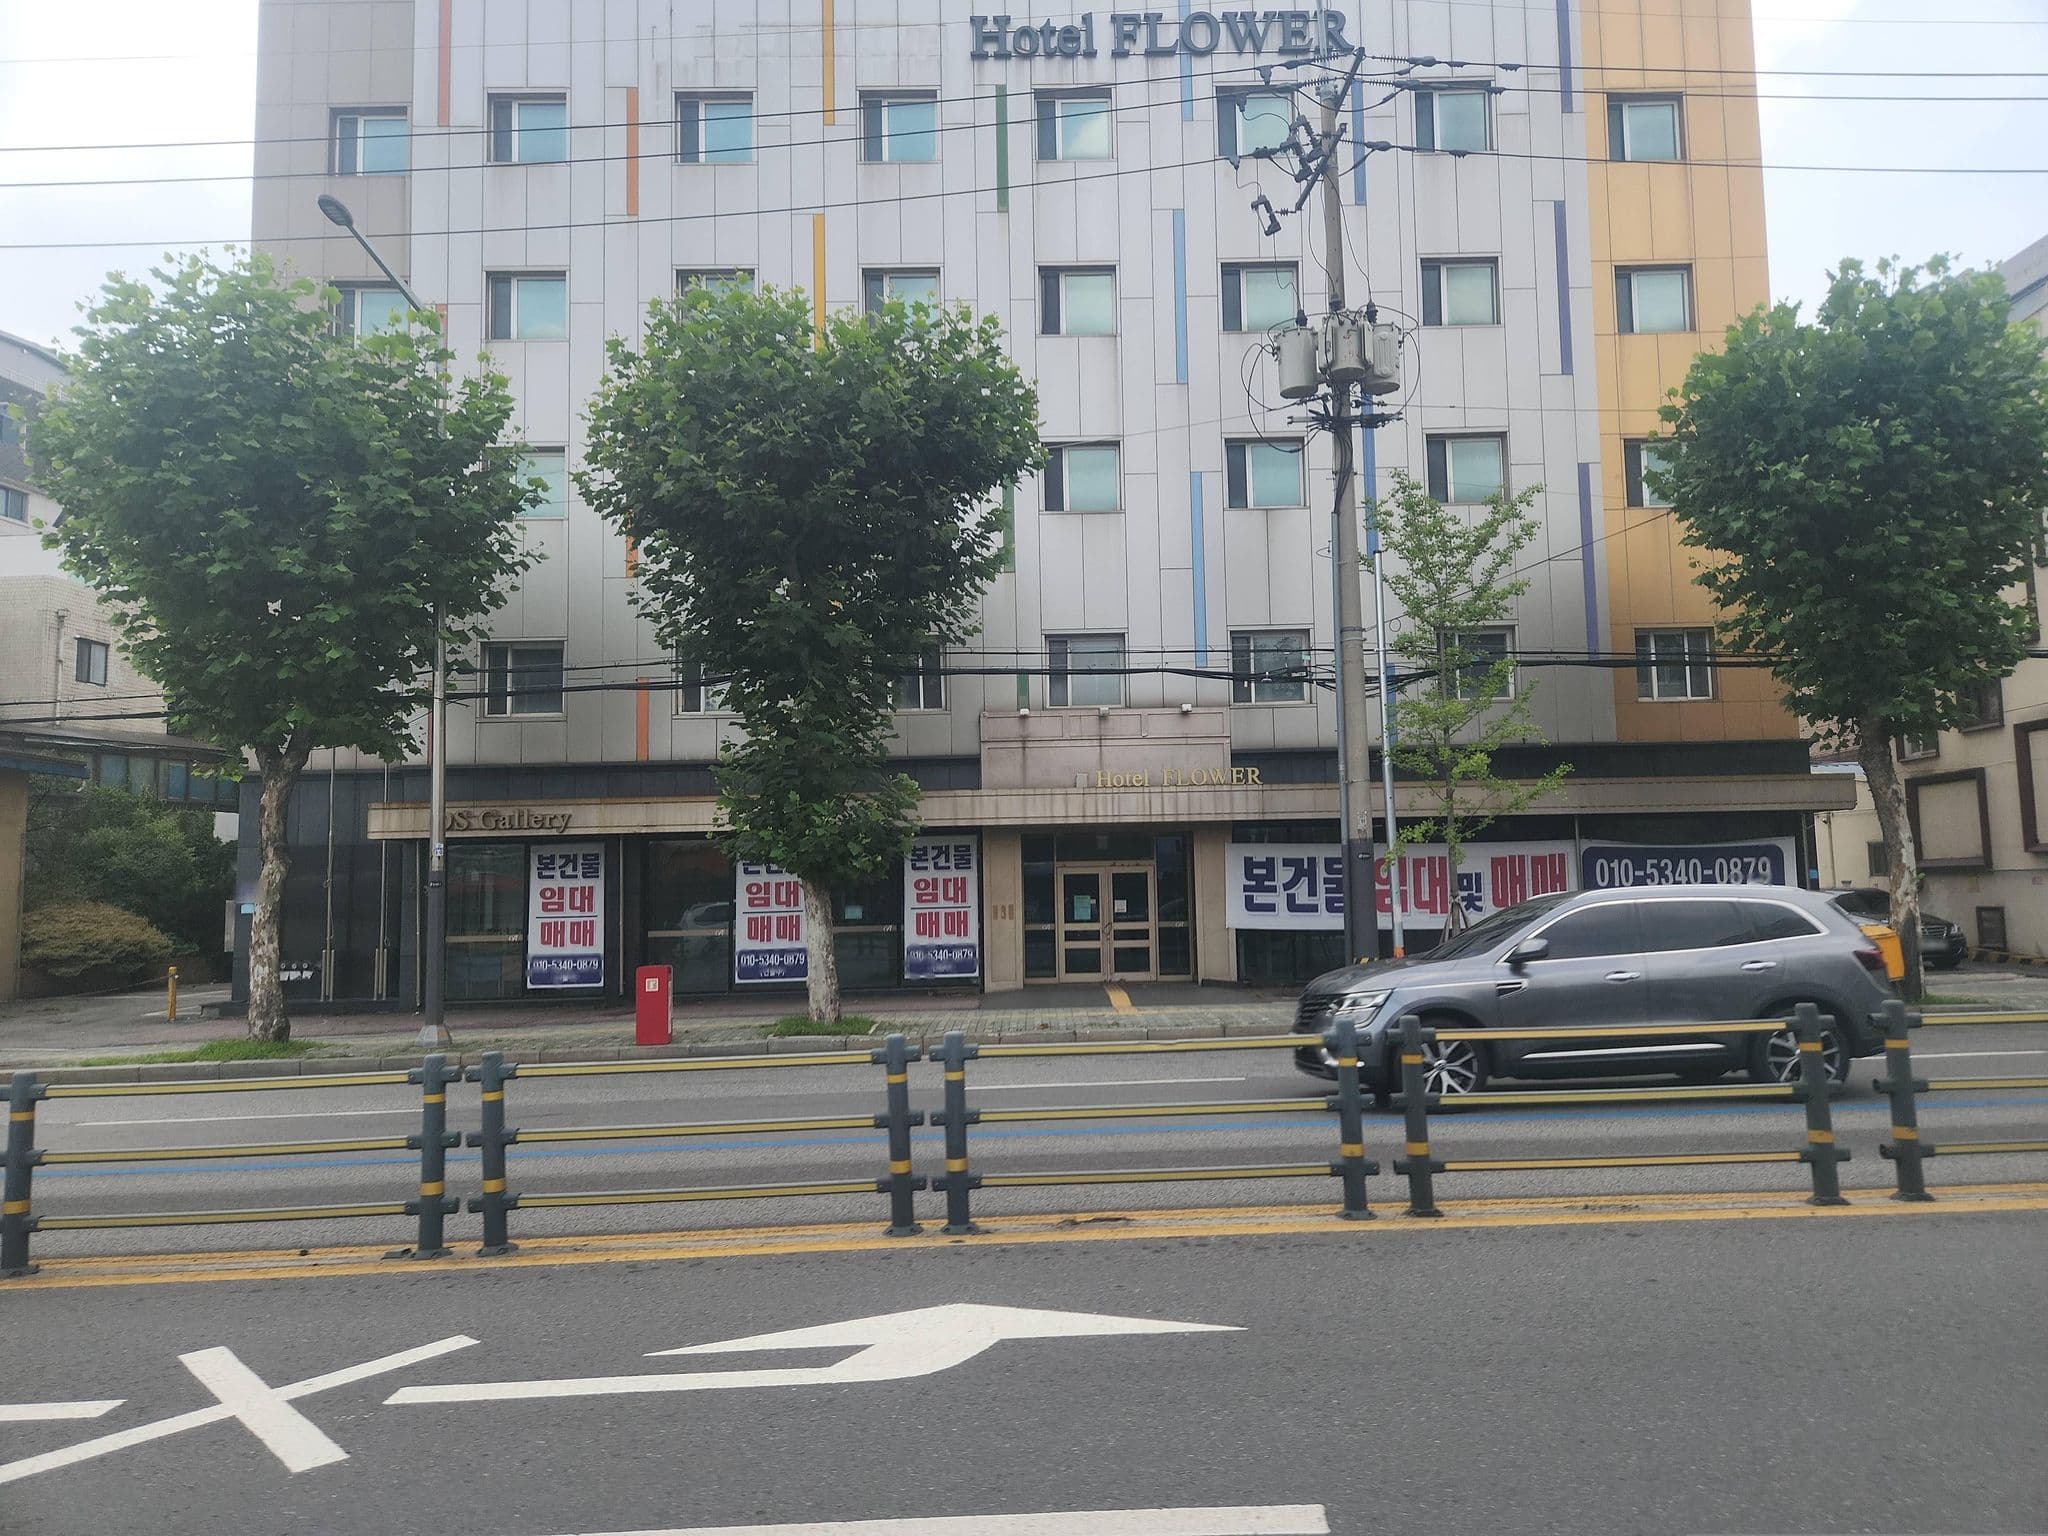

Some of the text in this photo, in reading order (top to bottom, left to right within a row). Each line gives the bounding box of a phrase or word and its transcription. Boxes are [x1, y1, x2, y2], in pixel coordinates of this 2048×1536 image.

[970, 10, 1355, 57] Hotel FLOWER
[1096, 767, 1264, 788] Hotel FLOWER
[480, 808, 572, 833] Gallery
[537, 853, 600, 880] 본건물
[911, 845, 971, 871] 본건물
[1595, 856, 1772, 887] 010-5340-0879
[746, 881, 799, 908] 임대
[914, 876, 967, 904] 임대
[1375, 856, 1449, 914] 임대
[1457, 871, 1483, 912] 및
[1491, 853, 1567, 908] 매매
[540, 886, 594, 913] 임대
[541, 920, 595, 948] 매매
[747, 915, 801, 943] 매매
[916, 911, 968, 938] 매매
[741, 953, 805, 967] 010-5340-0879
